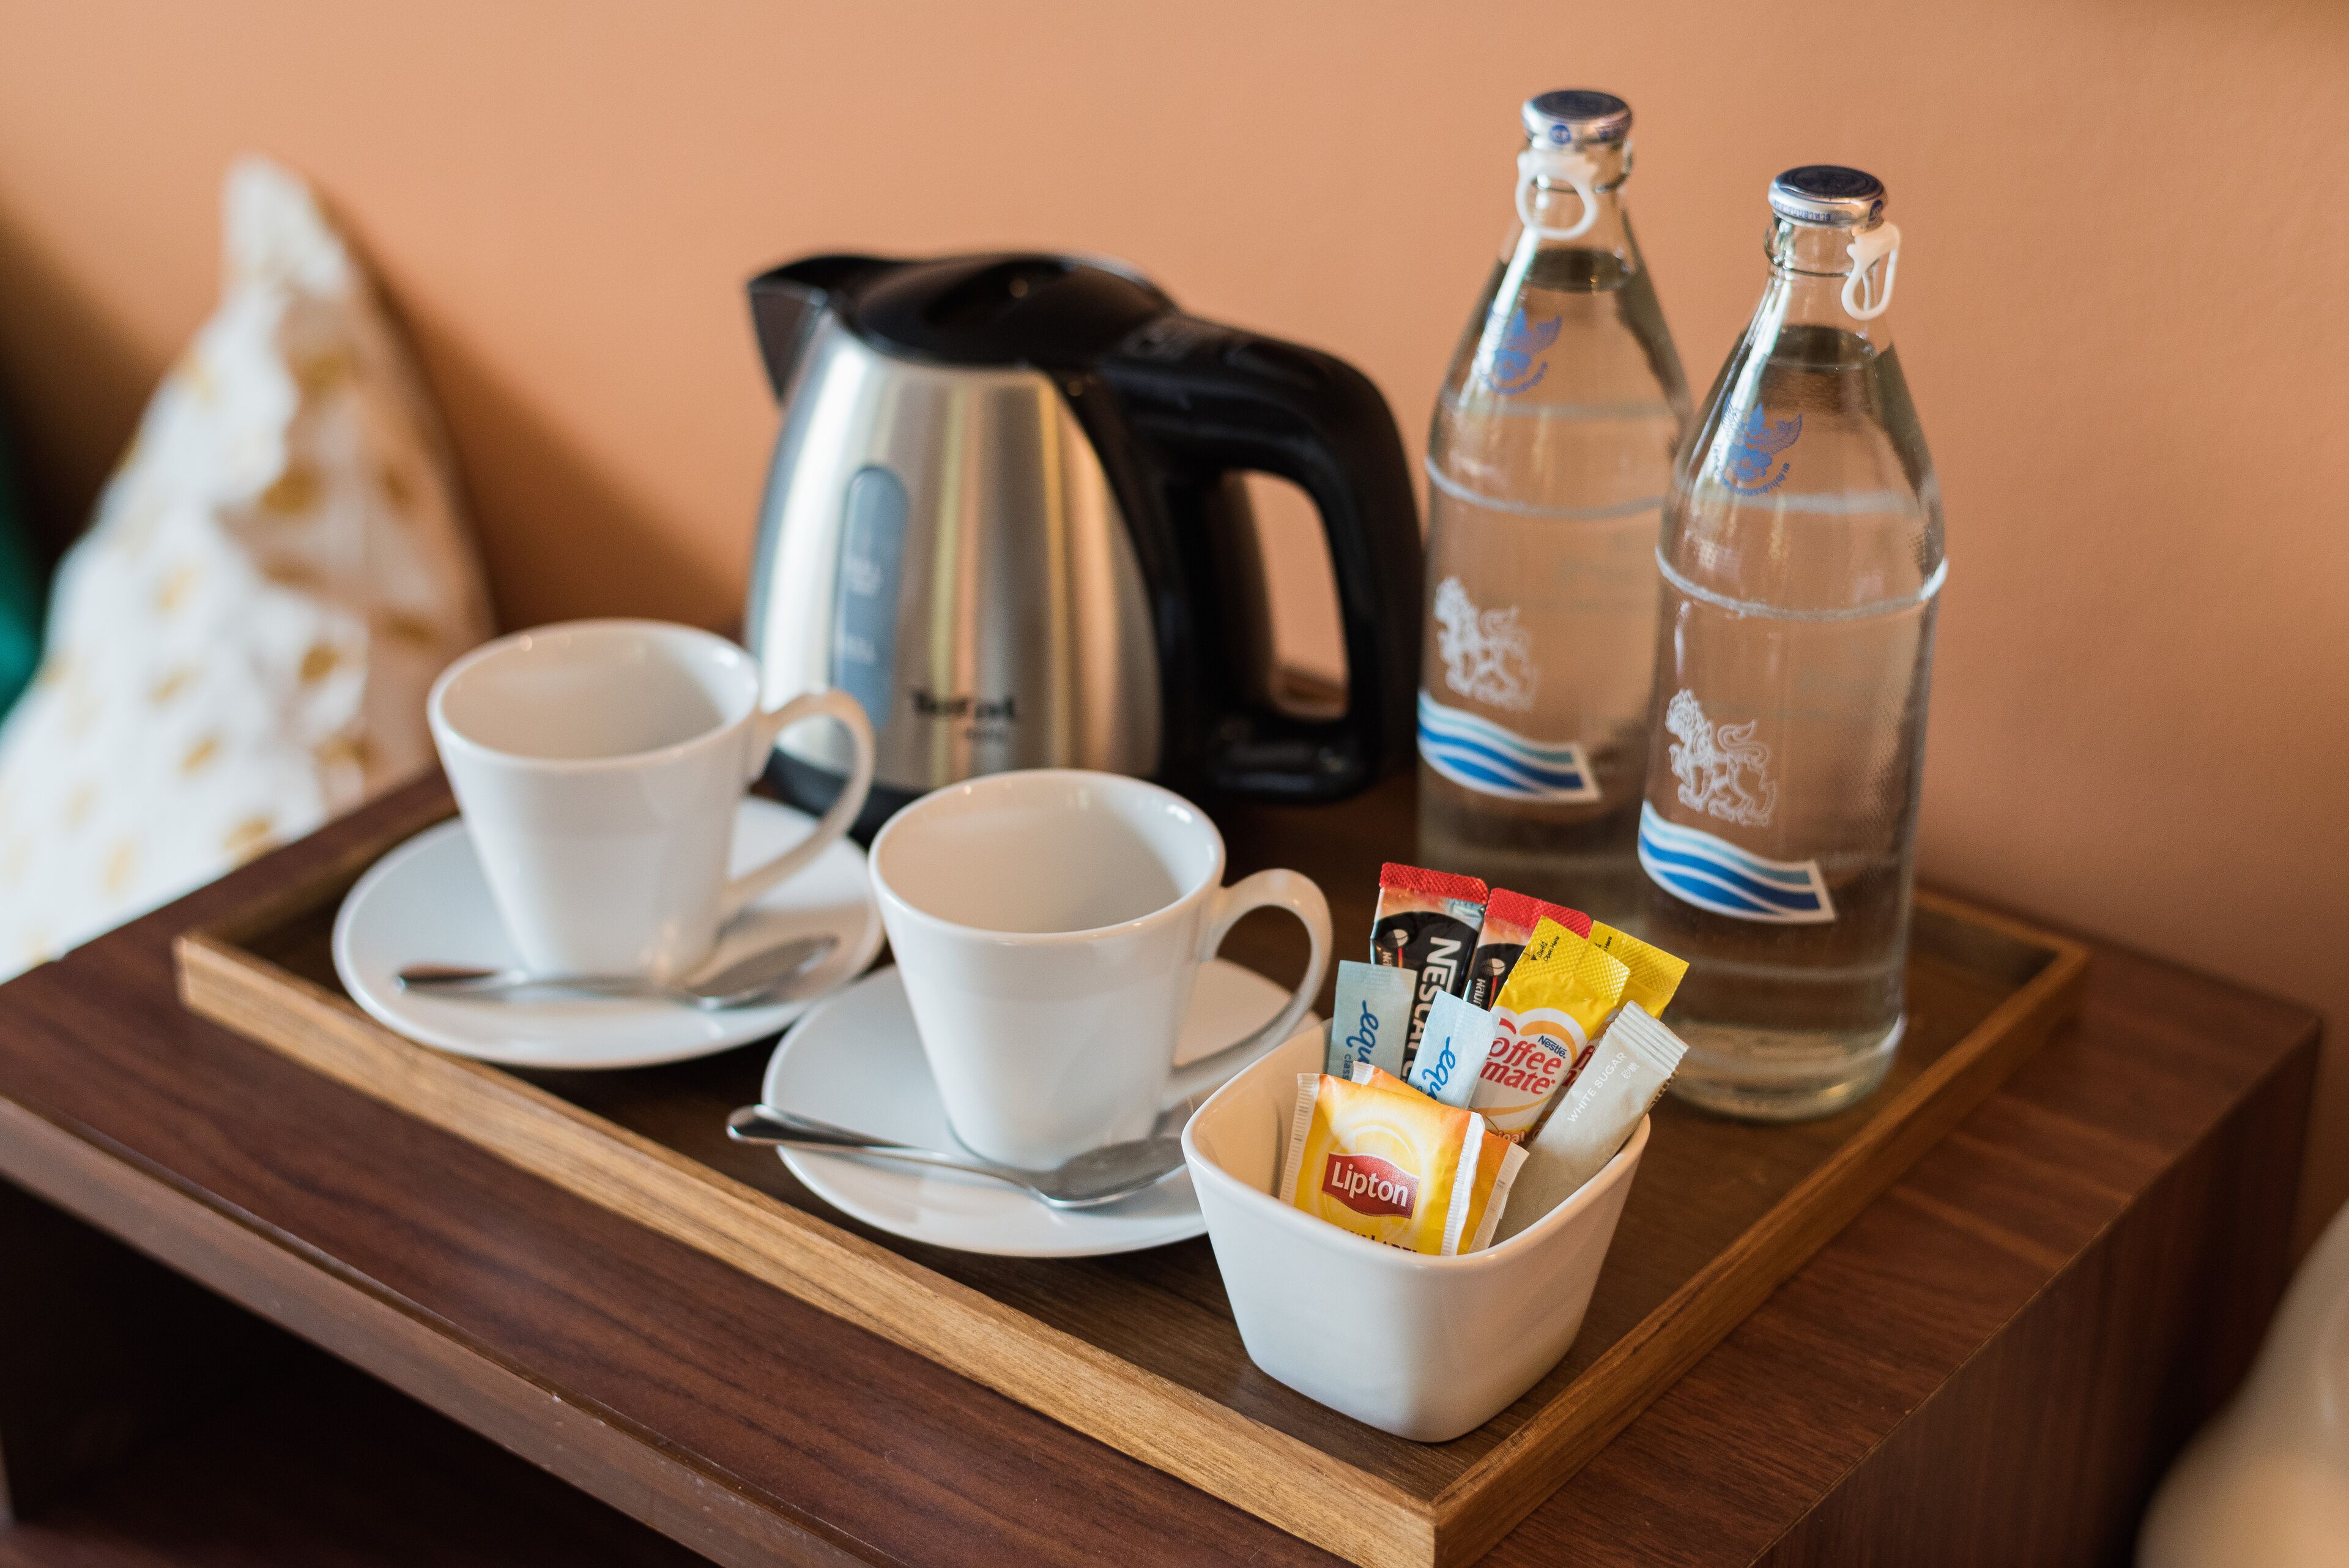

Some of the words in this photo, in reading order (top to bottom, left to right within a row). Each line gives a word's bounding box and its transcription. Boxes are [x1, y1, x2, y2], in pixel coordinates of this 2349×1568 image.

[1543, 948, 1554, 962] Open
[1551, 936, 1560, 949] Here
[1346, 1000, 1379, 1064] equ
[1422, 1036, 1455, 1100] equ
[1480, 1060, 1551, 1094] mate
[1489, 1037, 1562, 1074] offee
[1567, 1088, 1597, 1122] WHITE
[1594, 1052, 1627, 1088] SUGAR
[1331, 1161, 1408, 1207] Lipton
